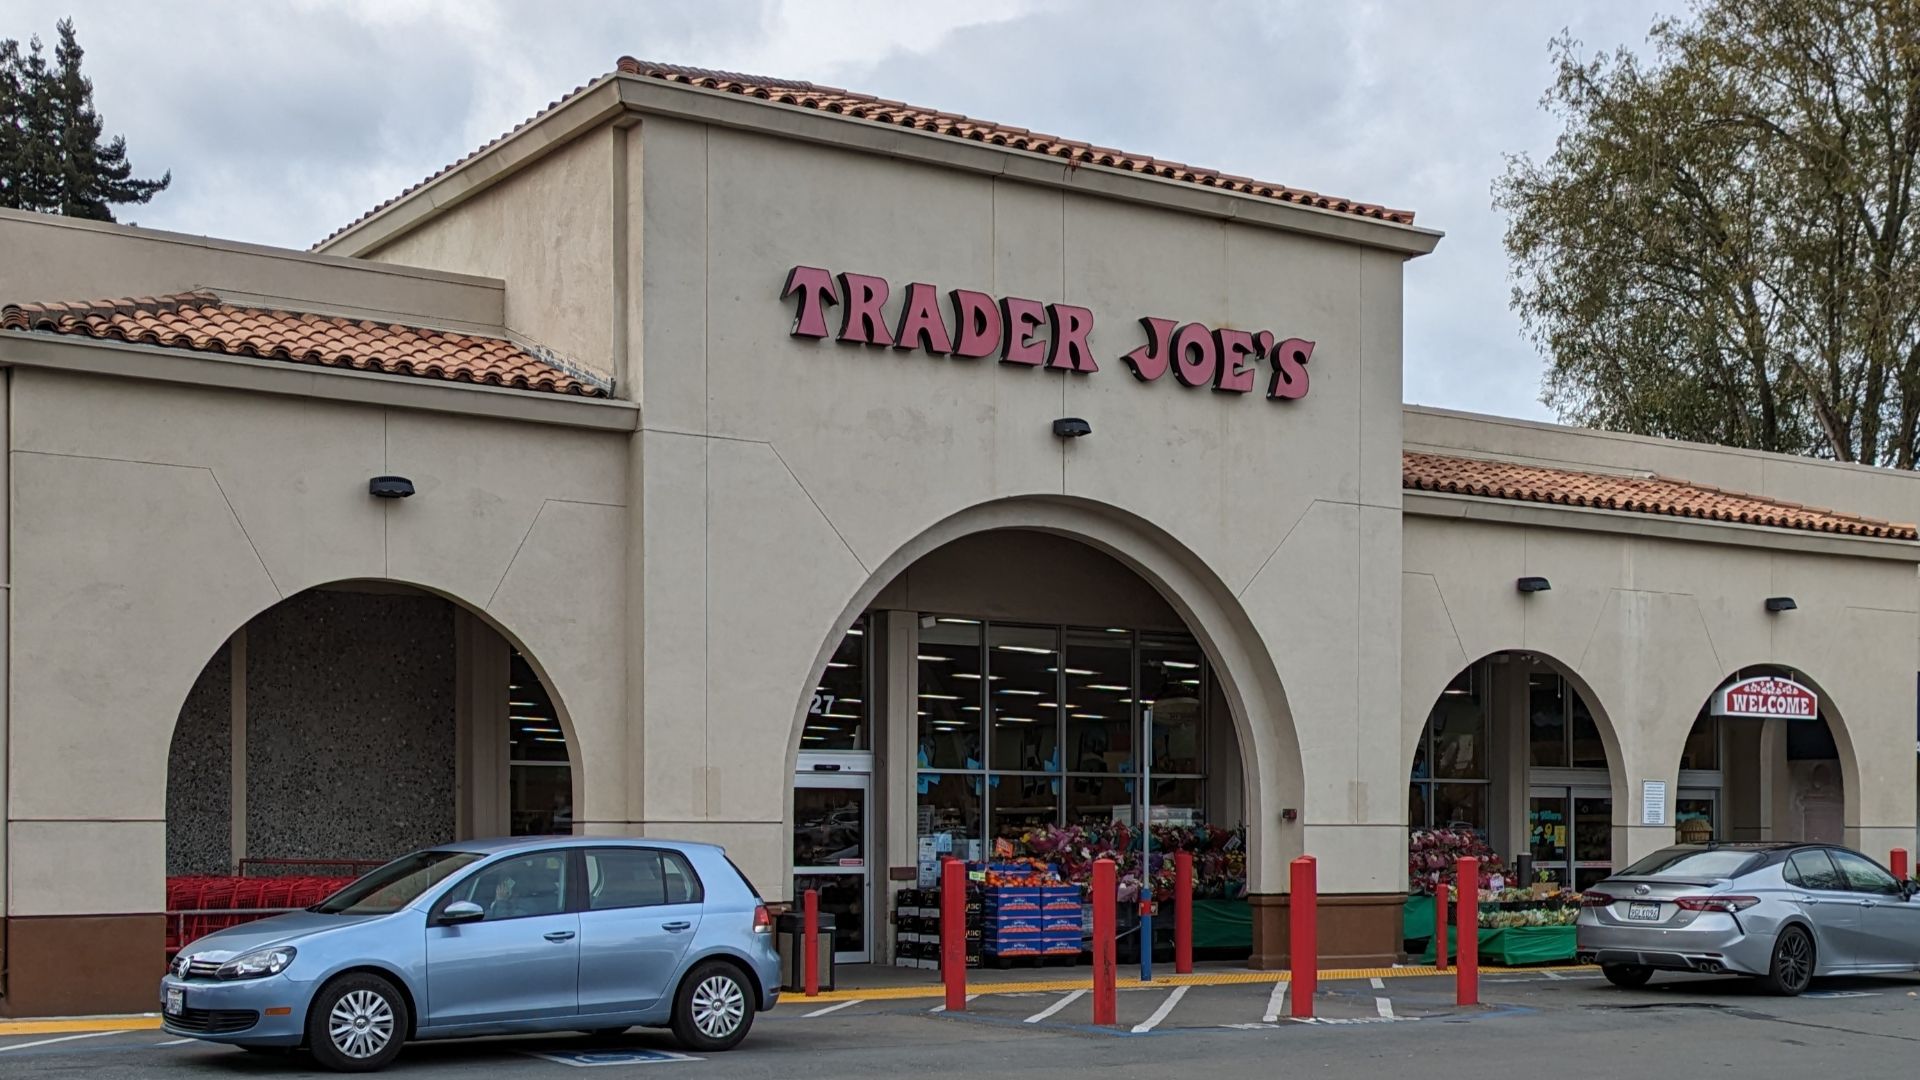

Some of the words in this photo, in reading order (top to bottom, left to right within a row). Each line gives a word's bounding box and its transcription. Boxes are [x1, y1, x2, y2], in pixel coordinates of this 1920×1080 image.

[780, 265, 1099, 374] TRADER
[1121, 316, 1316, 401] JOE'S
[1732, 694, 1810, 714] WELCOME
